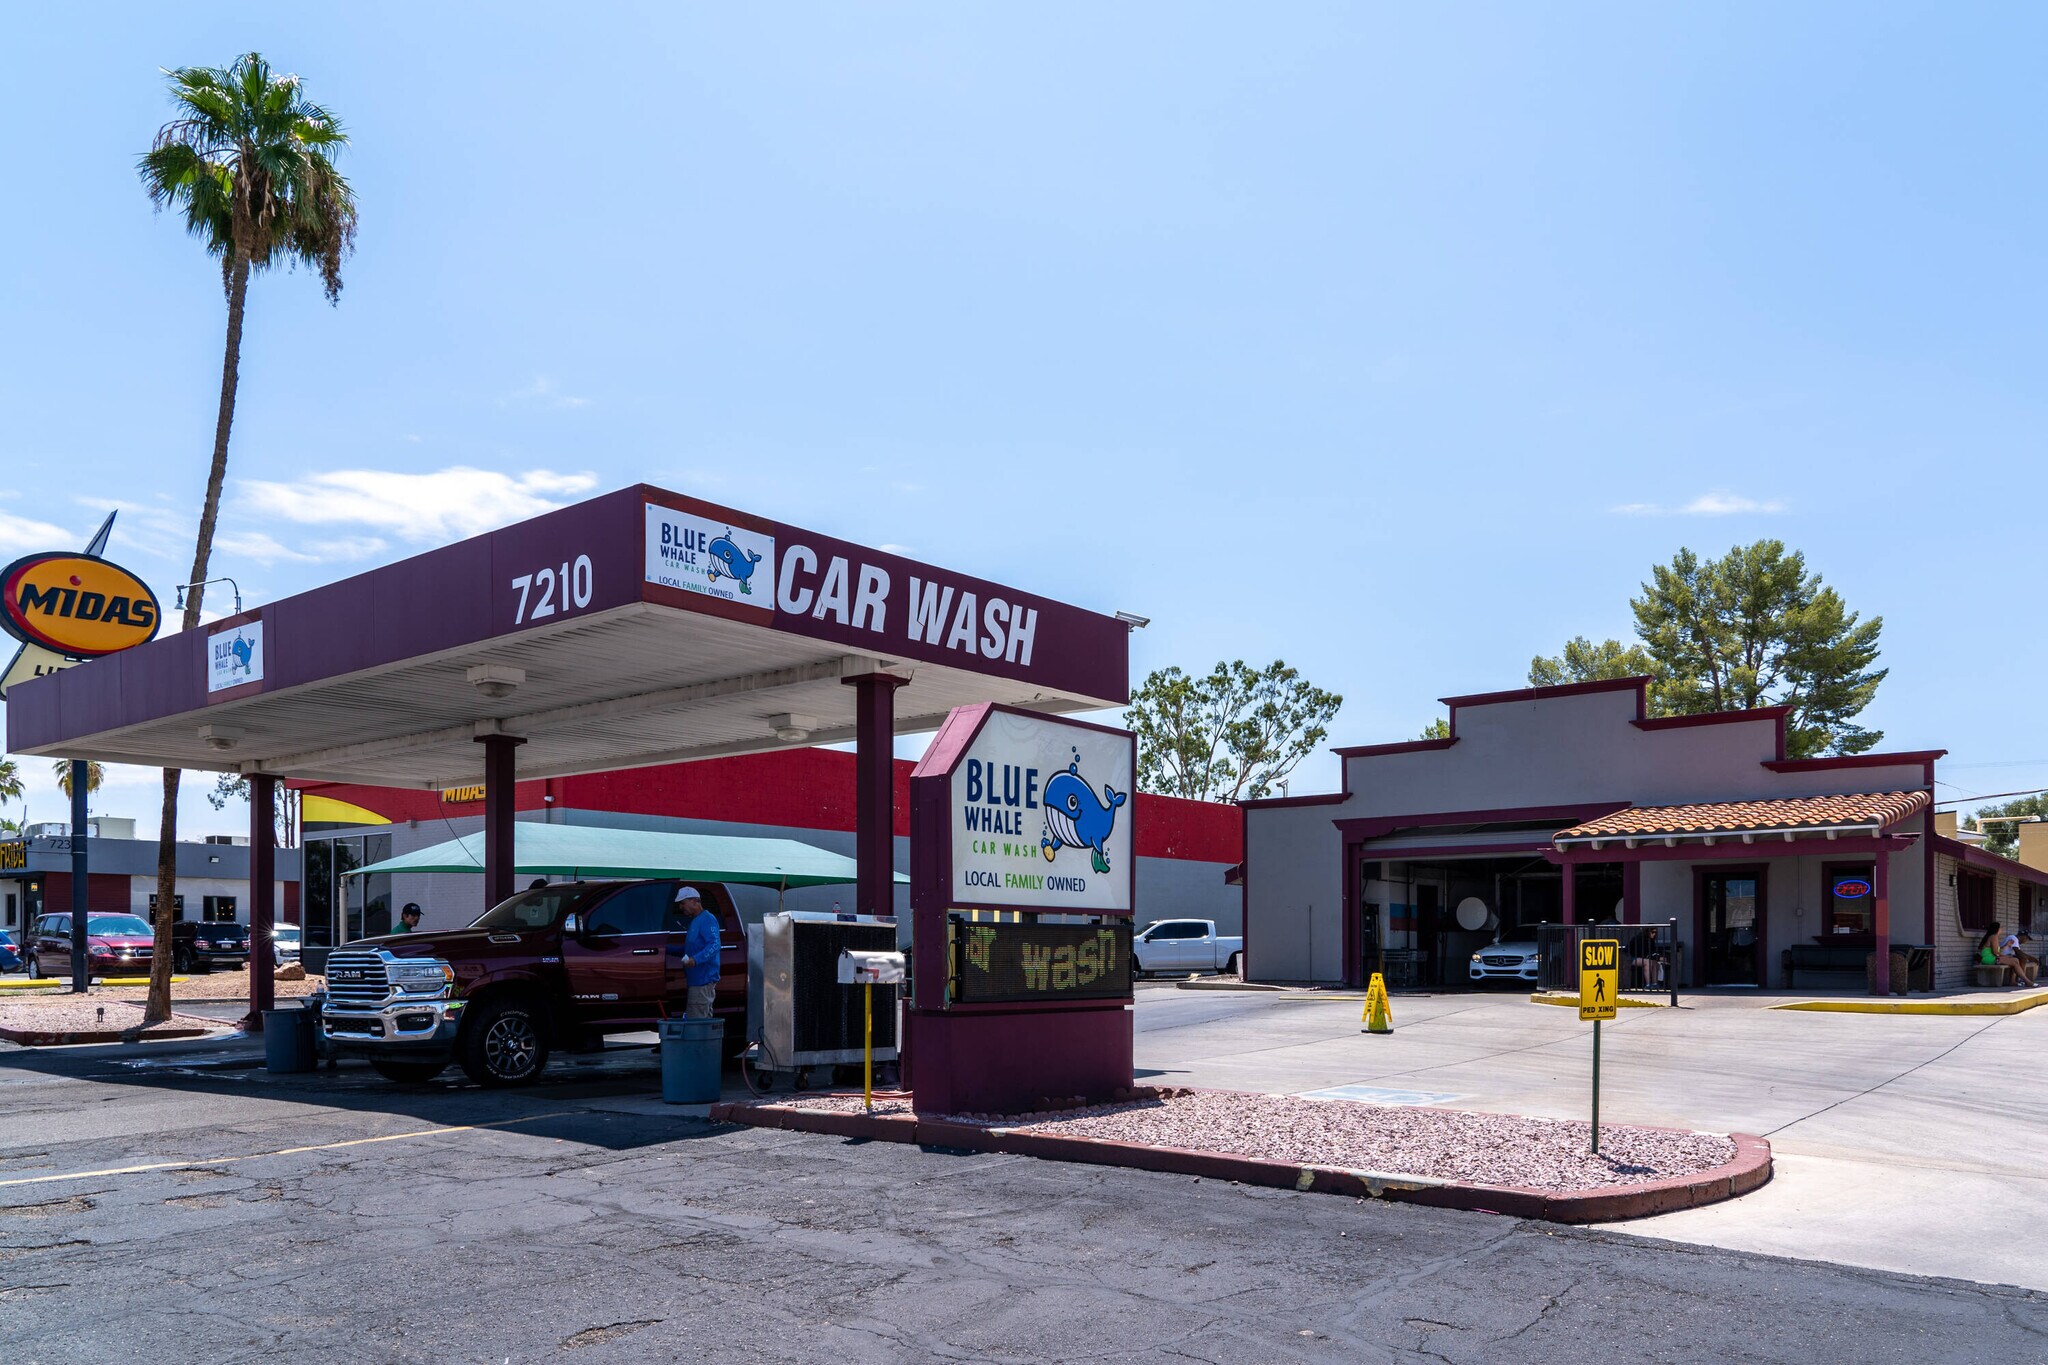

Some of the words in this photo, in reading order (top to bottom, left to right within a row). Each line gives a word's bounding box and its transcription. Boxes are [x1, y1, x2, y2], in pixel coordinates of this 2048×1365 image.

[661, 522, 706, 553] BLUE
[660, 545, 697, 565] WHALE
[665, 560, 679, 569] CAR
[684, 564, 706, 575] WASH
[511, 554, 593, 625] 7210
[659, 576, 681, 587] LOCAL
[682, 581, 708, 593] FAMILY
[708, 587, 734, 599] OWNED
[18, 582, 155, 628] MIDAS
[777, 545, 891, 633] CAR
[907, 576, 1038, 667] WASH
[215, 642, 231, 660] BLUE
[967, 758, 1038, 810] BLUE
[965, 805, 1022, 836] WHALE
[973, 840, 996, 854] CAR
[1003, 843, 1038, 858] WASH
[965, 870, 1001, 888] LOCAL
[1005, 873, 1043, 890] FAMILY
[1047, 876, 1086, 892] OWNED
[1585, 946, 1614, 966] SLOW
[1582, 1006, 1596, 1014] PED
[1598, 1005, 1614, 1013] XING
